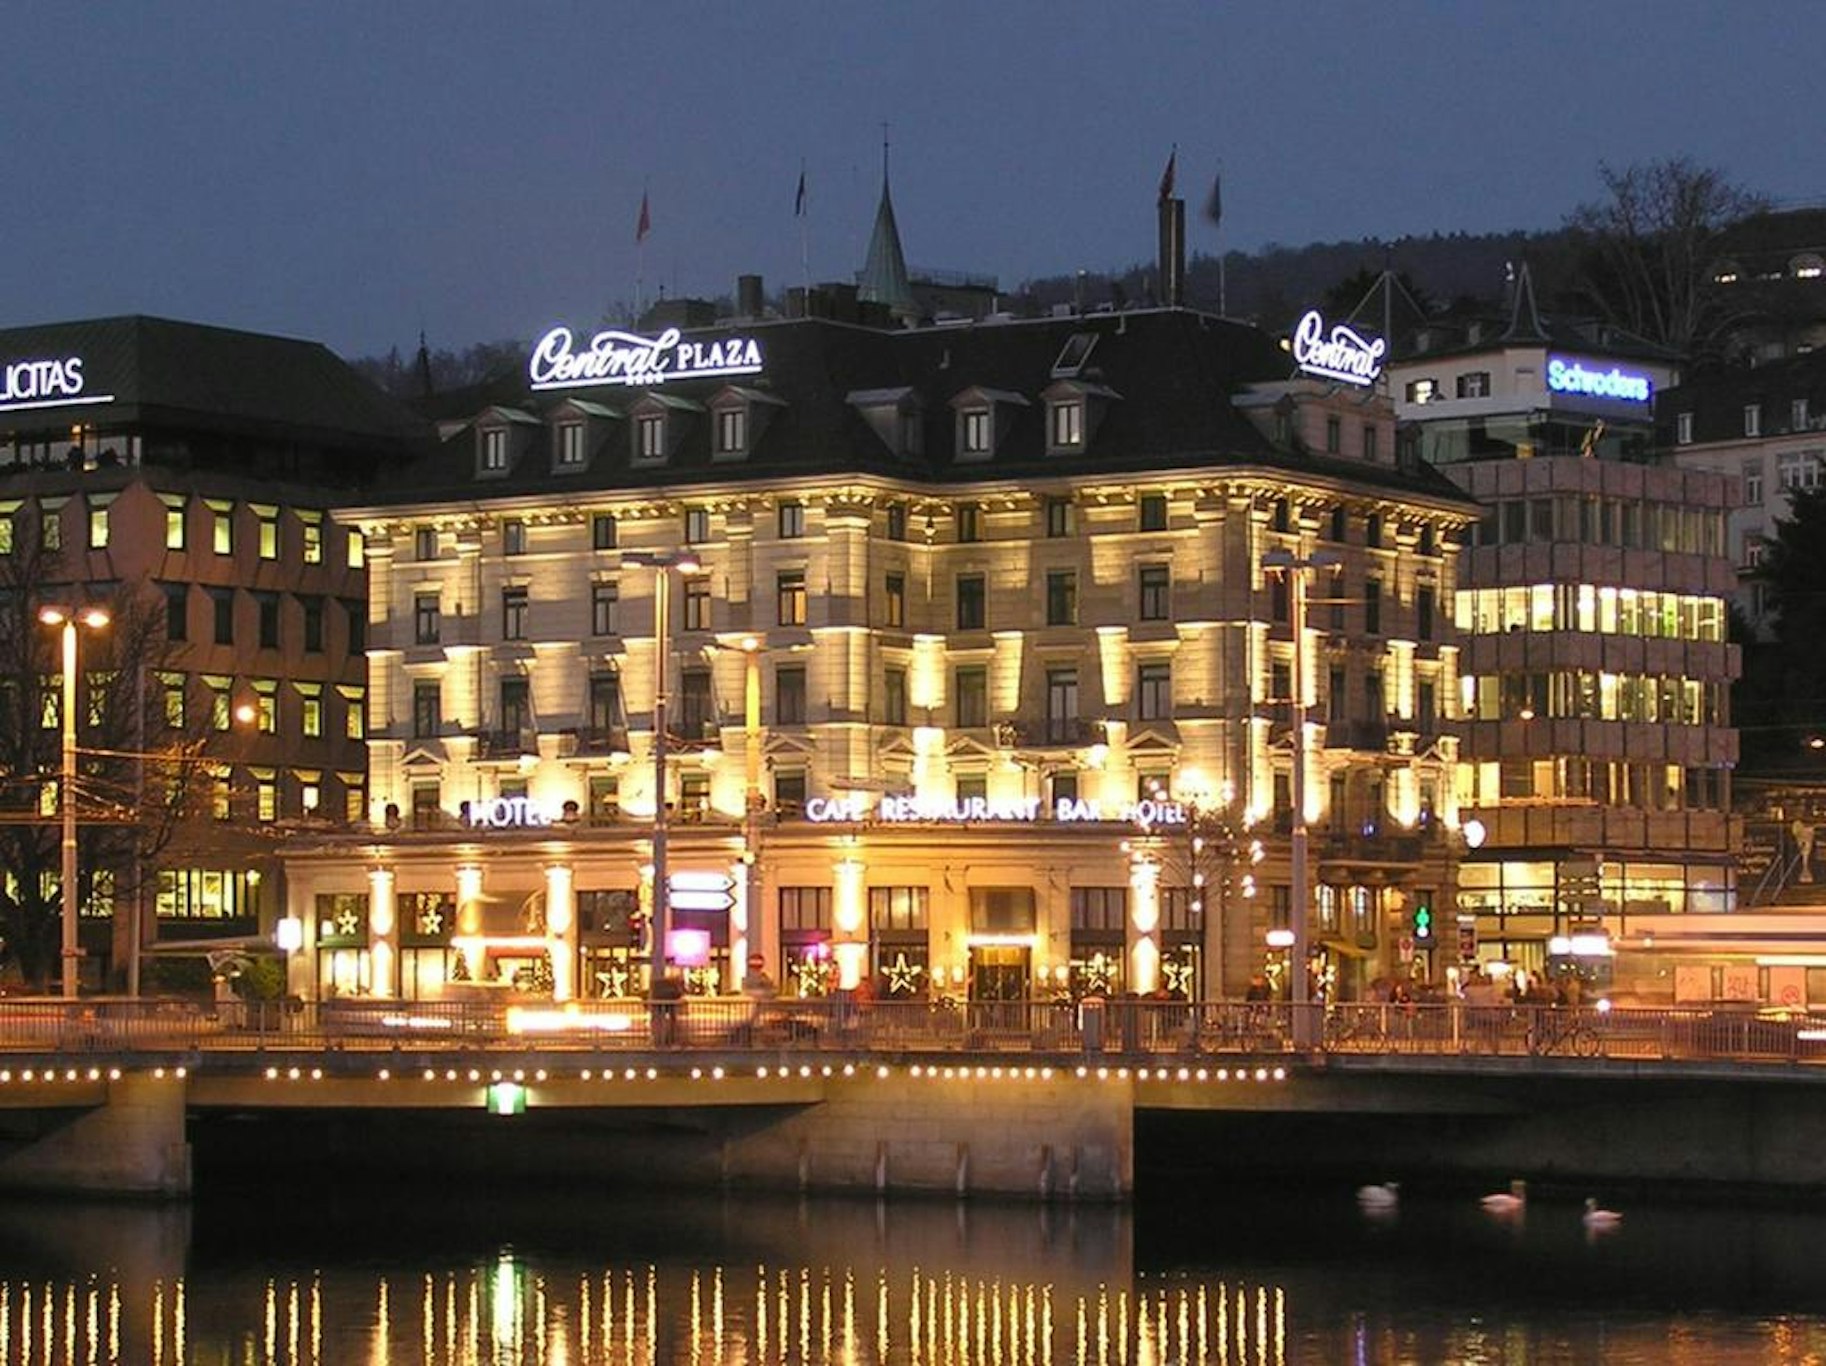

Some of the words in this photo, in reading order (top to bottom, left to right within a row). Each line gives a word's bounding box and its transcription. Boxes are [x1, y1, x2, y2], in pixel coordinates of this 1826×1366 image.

[530, 327, 681, 382] Central
[676, 339, 762, 371] PLAZA
[1293, 310, 1385, 379] Central
[0, 357, 84, 400] ICITAS
[879, 797, 1042, 821] RESTAURANT
[1057, 797, 1100, 822] BAR
